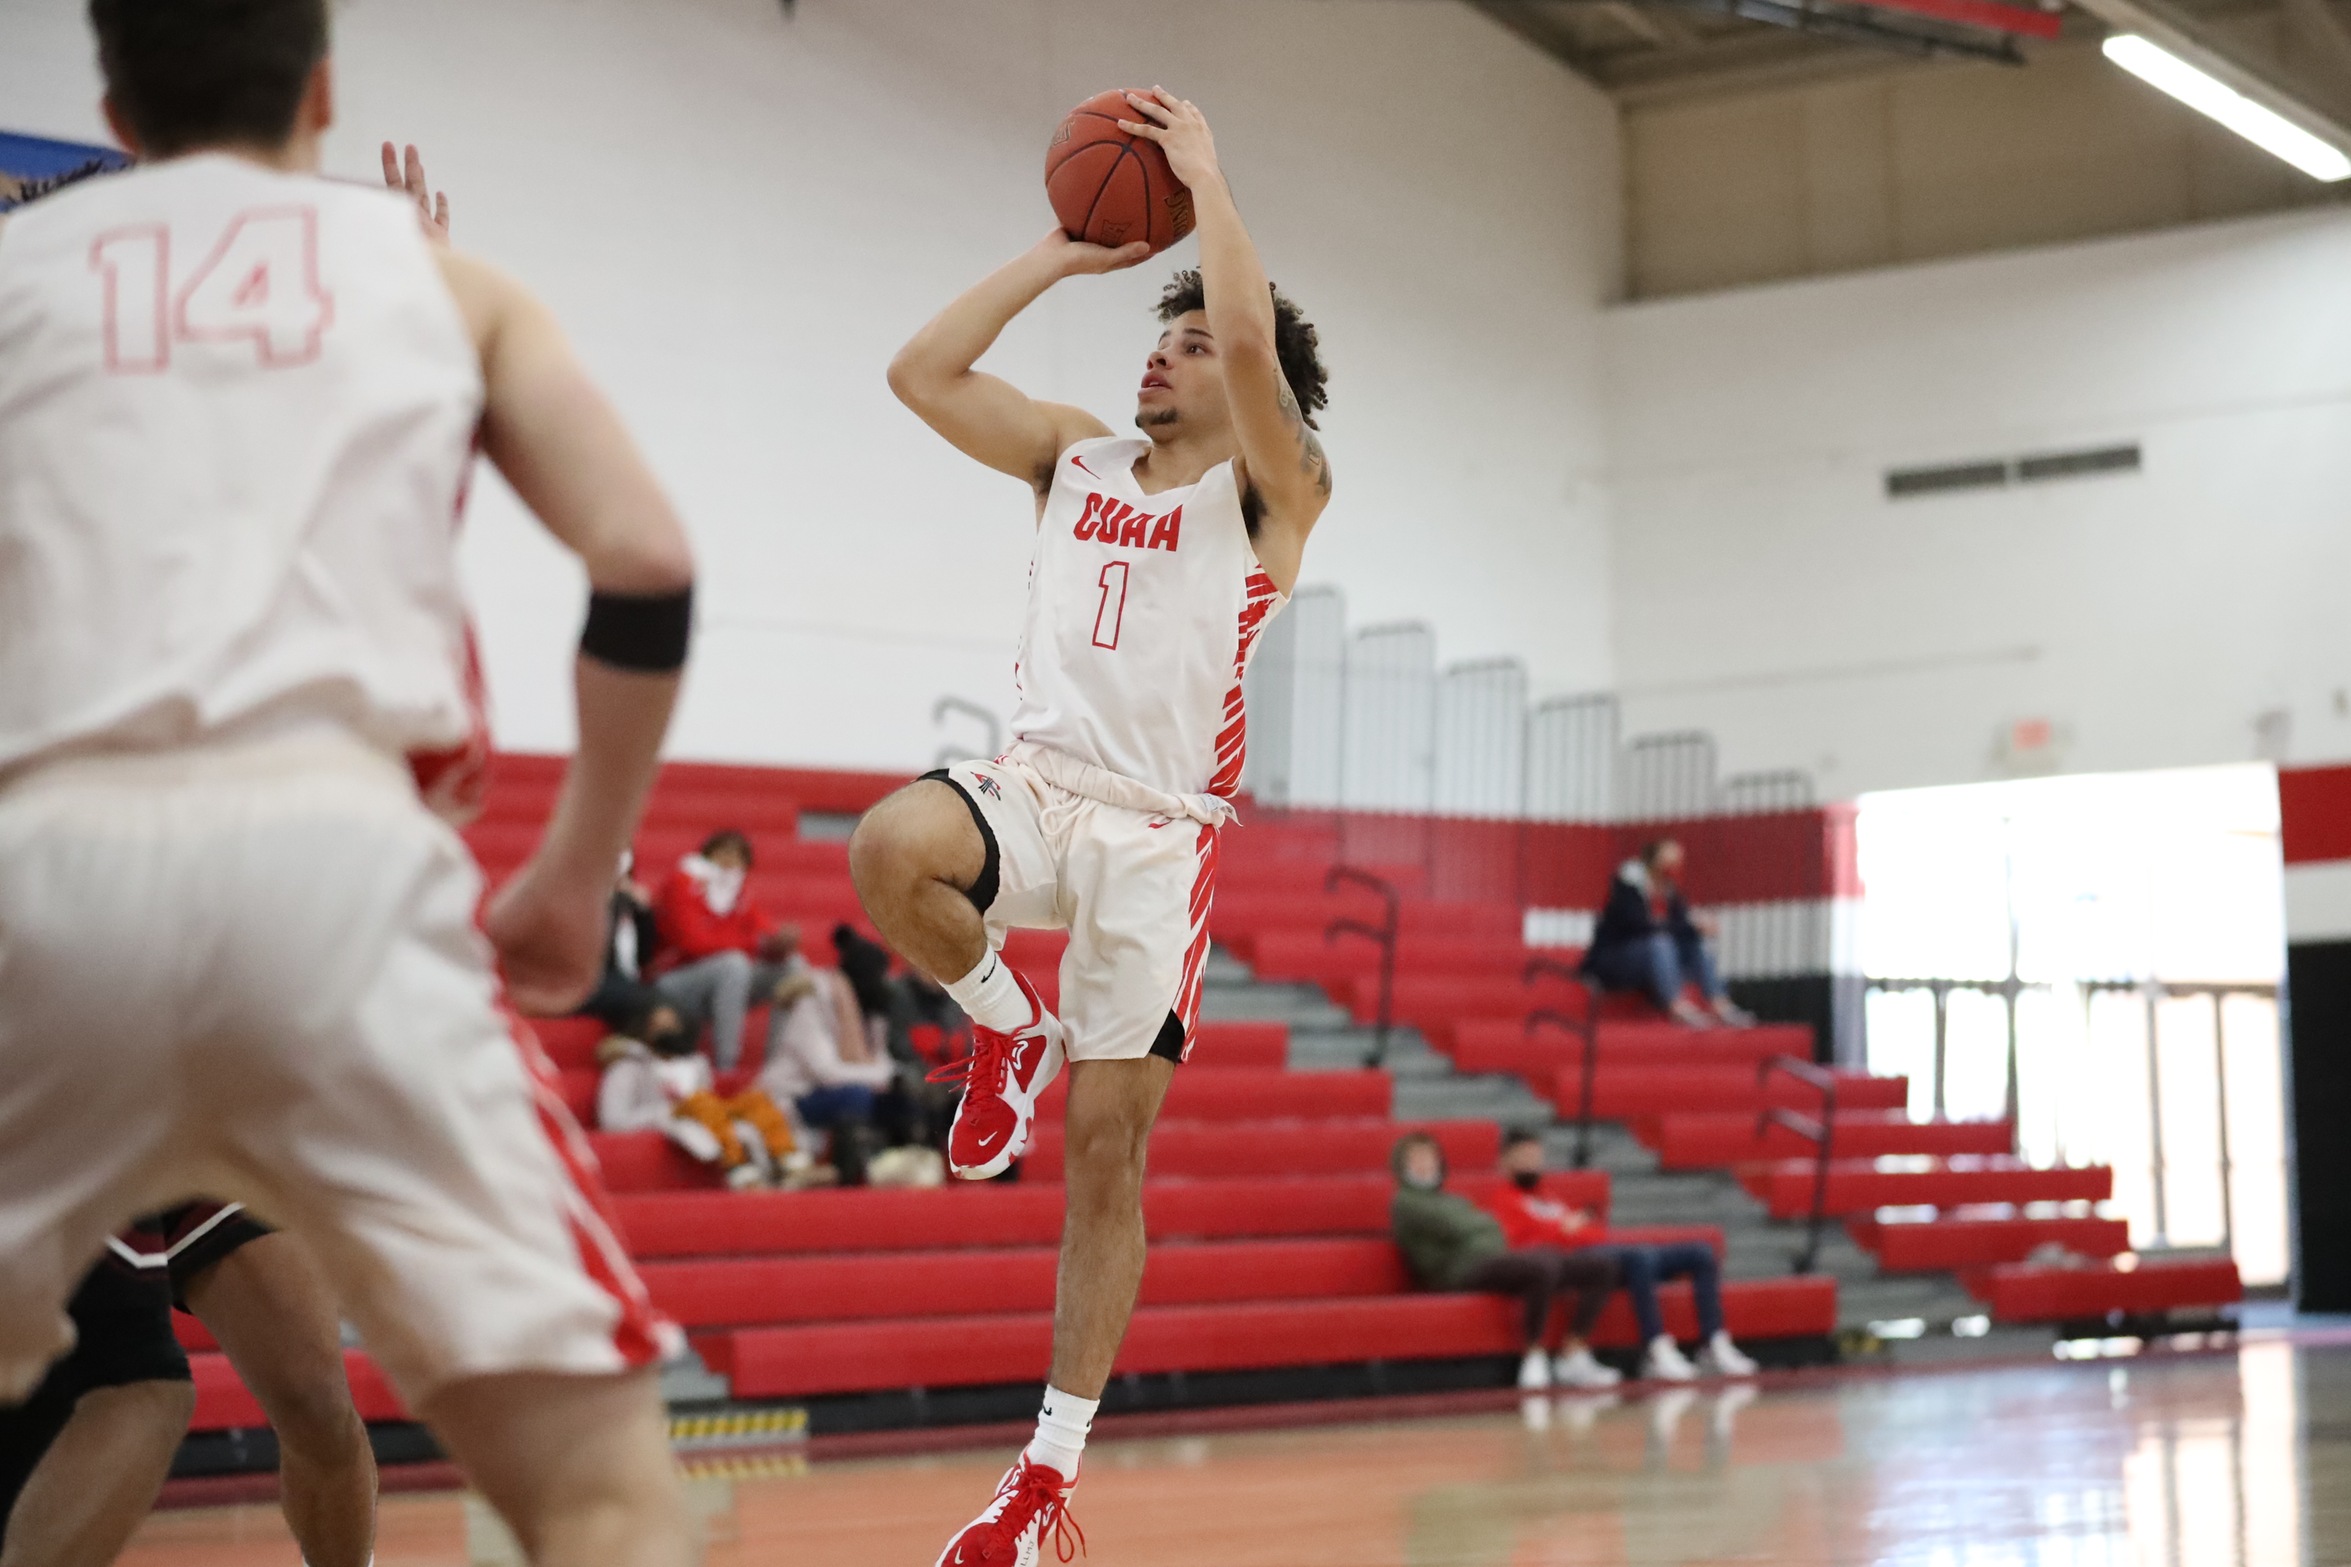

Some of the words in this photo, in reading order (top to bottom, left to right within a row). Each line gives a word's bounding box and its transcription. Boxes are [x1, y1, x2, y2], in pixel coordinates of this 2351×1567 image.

[88, 204, 335, 375] 14
[1073, 492, 1183, 552] CUAA
[1092, 560, 1130, 650] 1
